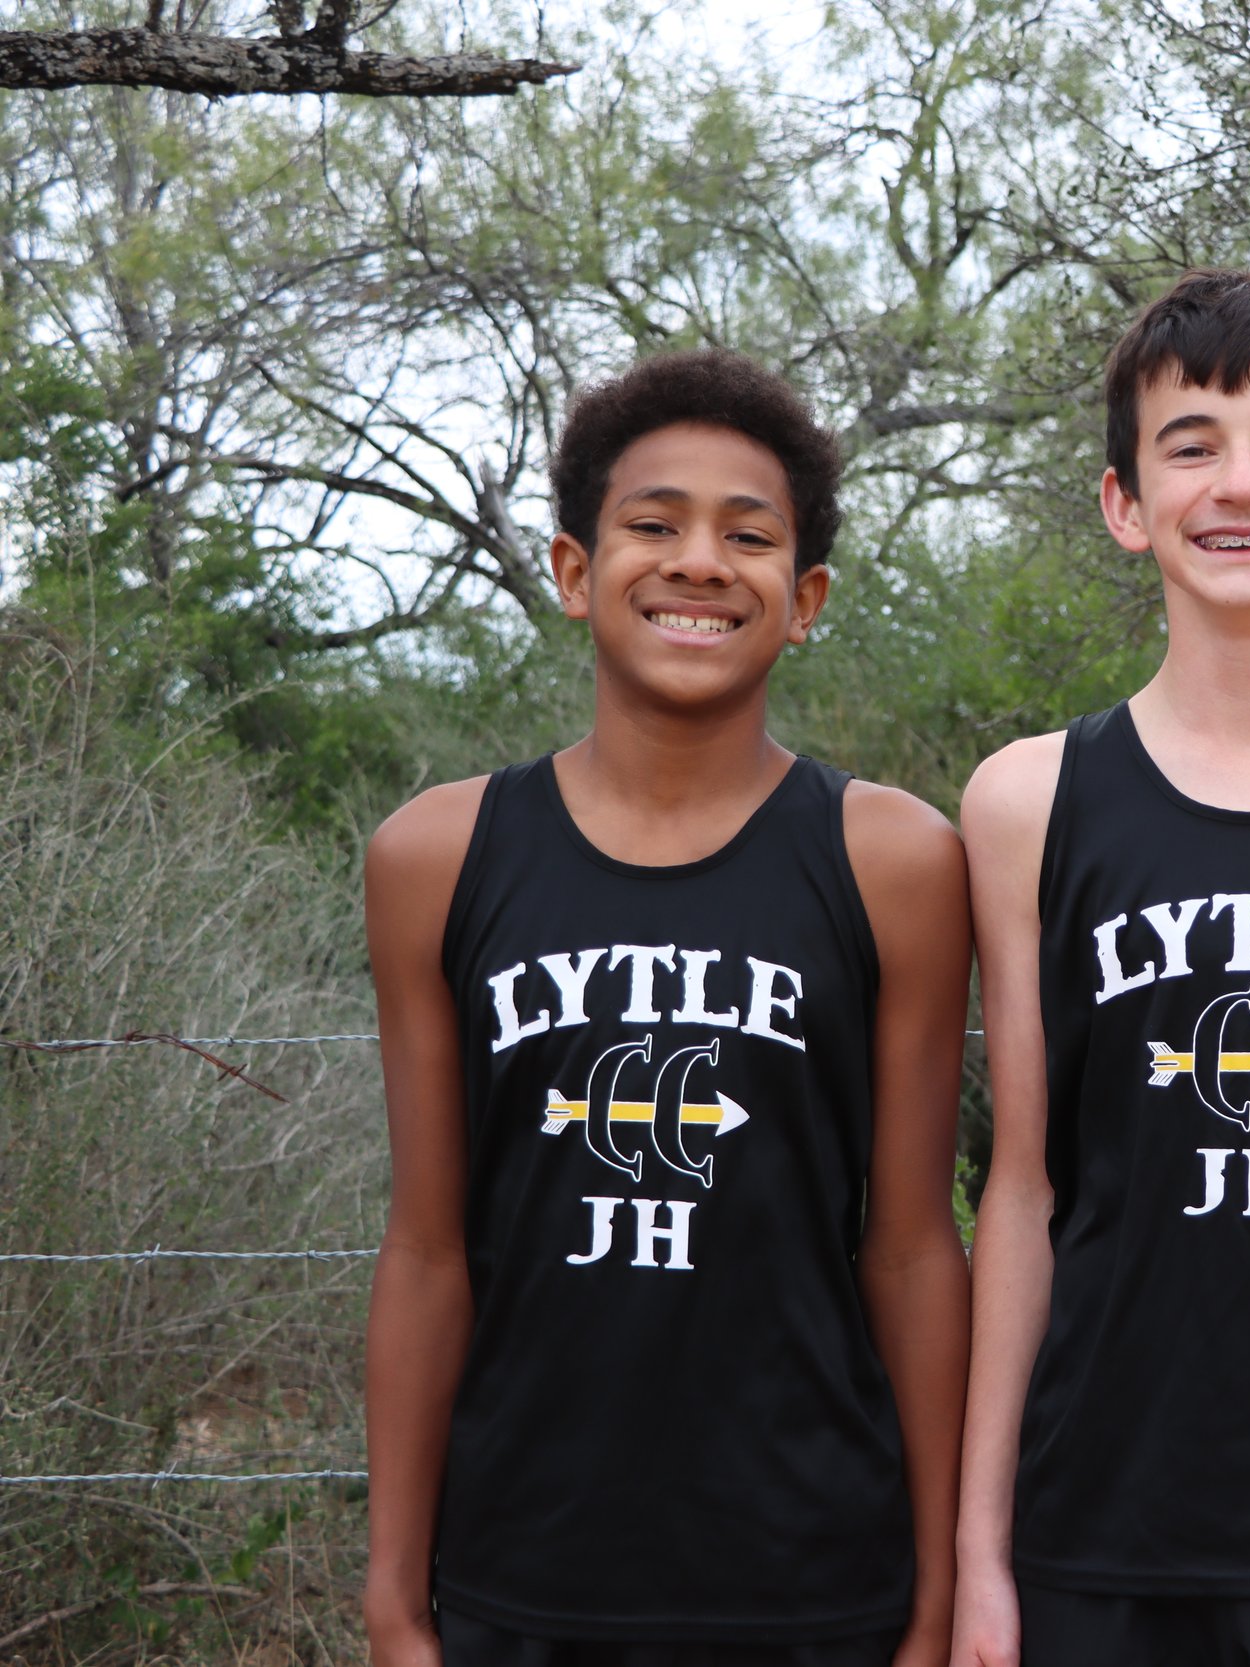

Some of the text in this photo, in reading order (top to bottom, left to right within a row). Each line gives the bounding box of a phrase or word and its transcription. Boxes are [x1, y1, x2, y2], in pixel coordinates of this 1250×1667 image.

[487, 943, 806, 1054] LYTLE
[585, 1032, 720, 1189] CC
[566, 1196, 698, 1270] JH
